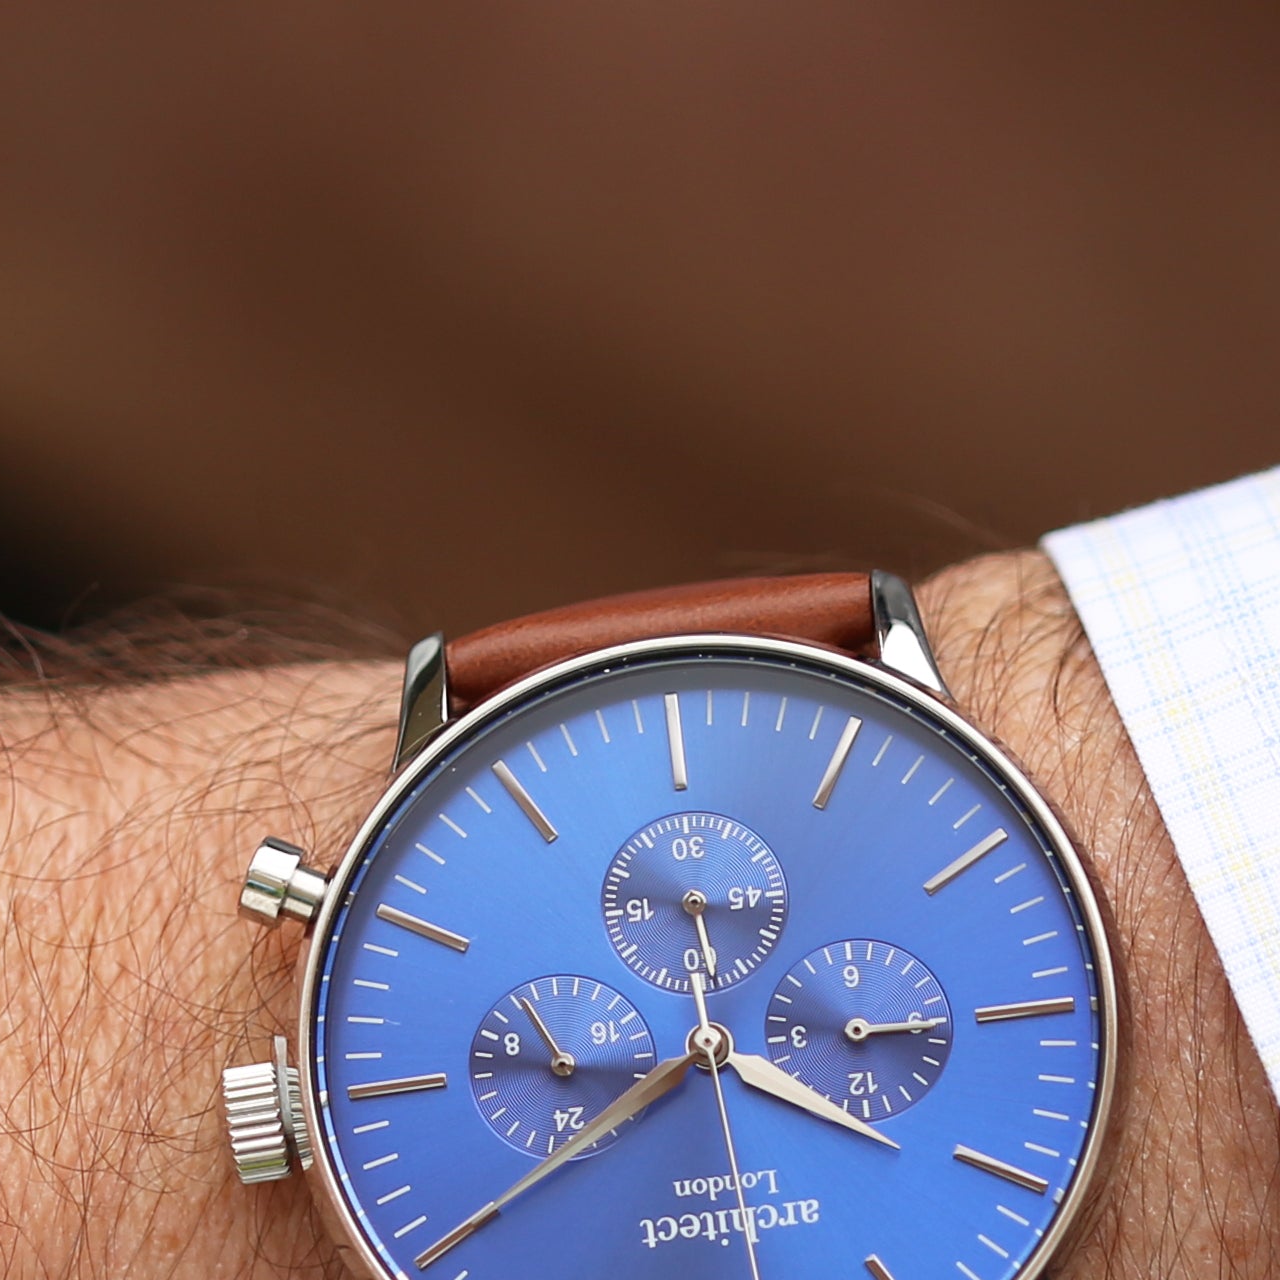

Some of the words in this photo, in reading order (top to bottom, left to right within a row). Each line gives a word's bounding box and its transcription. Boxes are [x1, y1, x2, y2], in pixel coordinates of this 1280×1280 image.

[672, 836, 705, 860] 30
[728, 885, 762, 910] 45
[626, 898, 654, 922] 15
[843, 965, 860, 988] 6
[504, 1032, 520, 1056] 8
[591, 1020, 620, 1045] 16
[790, 1025, 807, 1048] 3
[848, 1071, 878, 1095] 12
[553, 1106, 585, 1132] 24
[673, 1169, 780, 1201] London
[639, 1198, 820, 1248] architect
